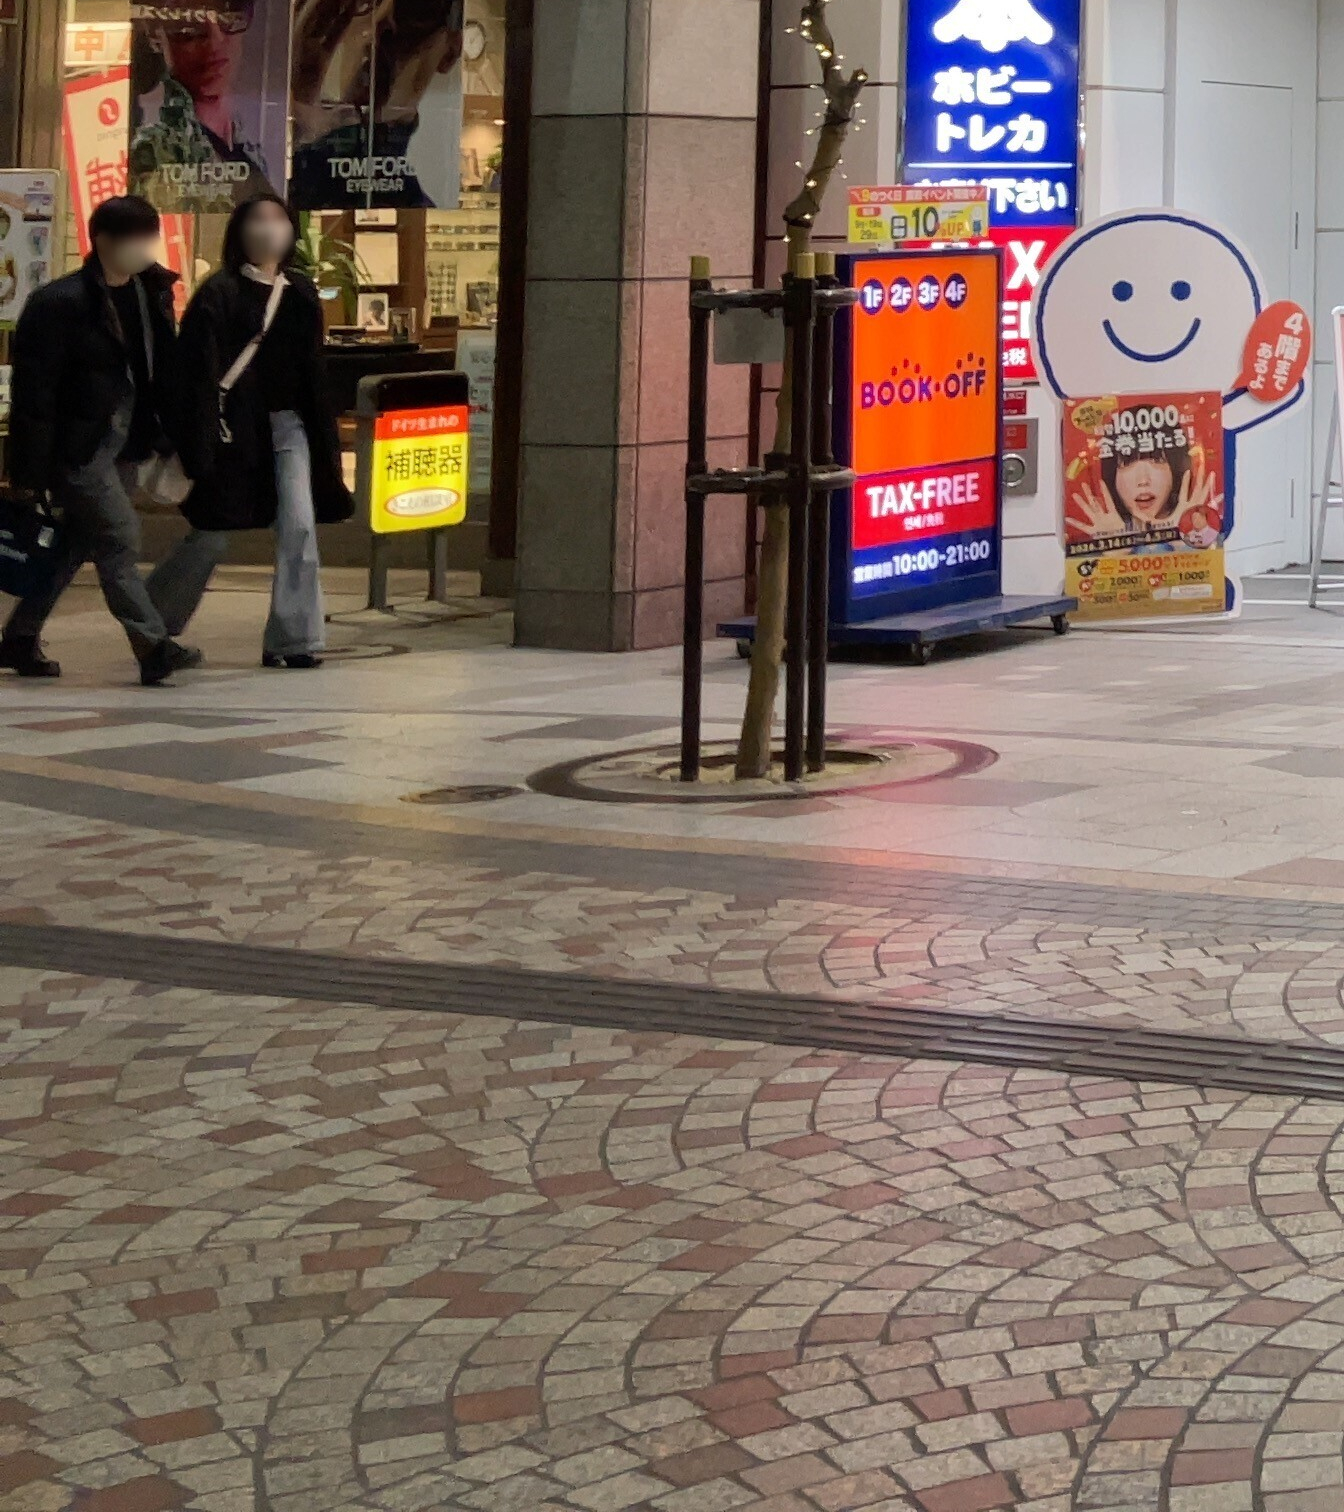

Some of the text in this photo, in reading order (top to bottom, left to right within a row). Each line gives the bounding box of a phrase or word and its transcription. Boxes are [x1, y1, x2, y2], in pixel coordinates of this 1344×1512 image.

[932, 66, 1053, 107] ホビー
[933, 110, 1047, 153] トレカ
[327, 157, 368, 179] TOM
[863, 279, 967, 309] 1F 2F 3F 4F
[385, 443, 463, 482] 補聴器
[866, 471, 981, 518] TAX-FREE
